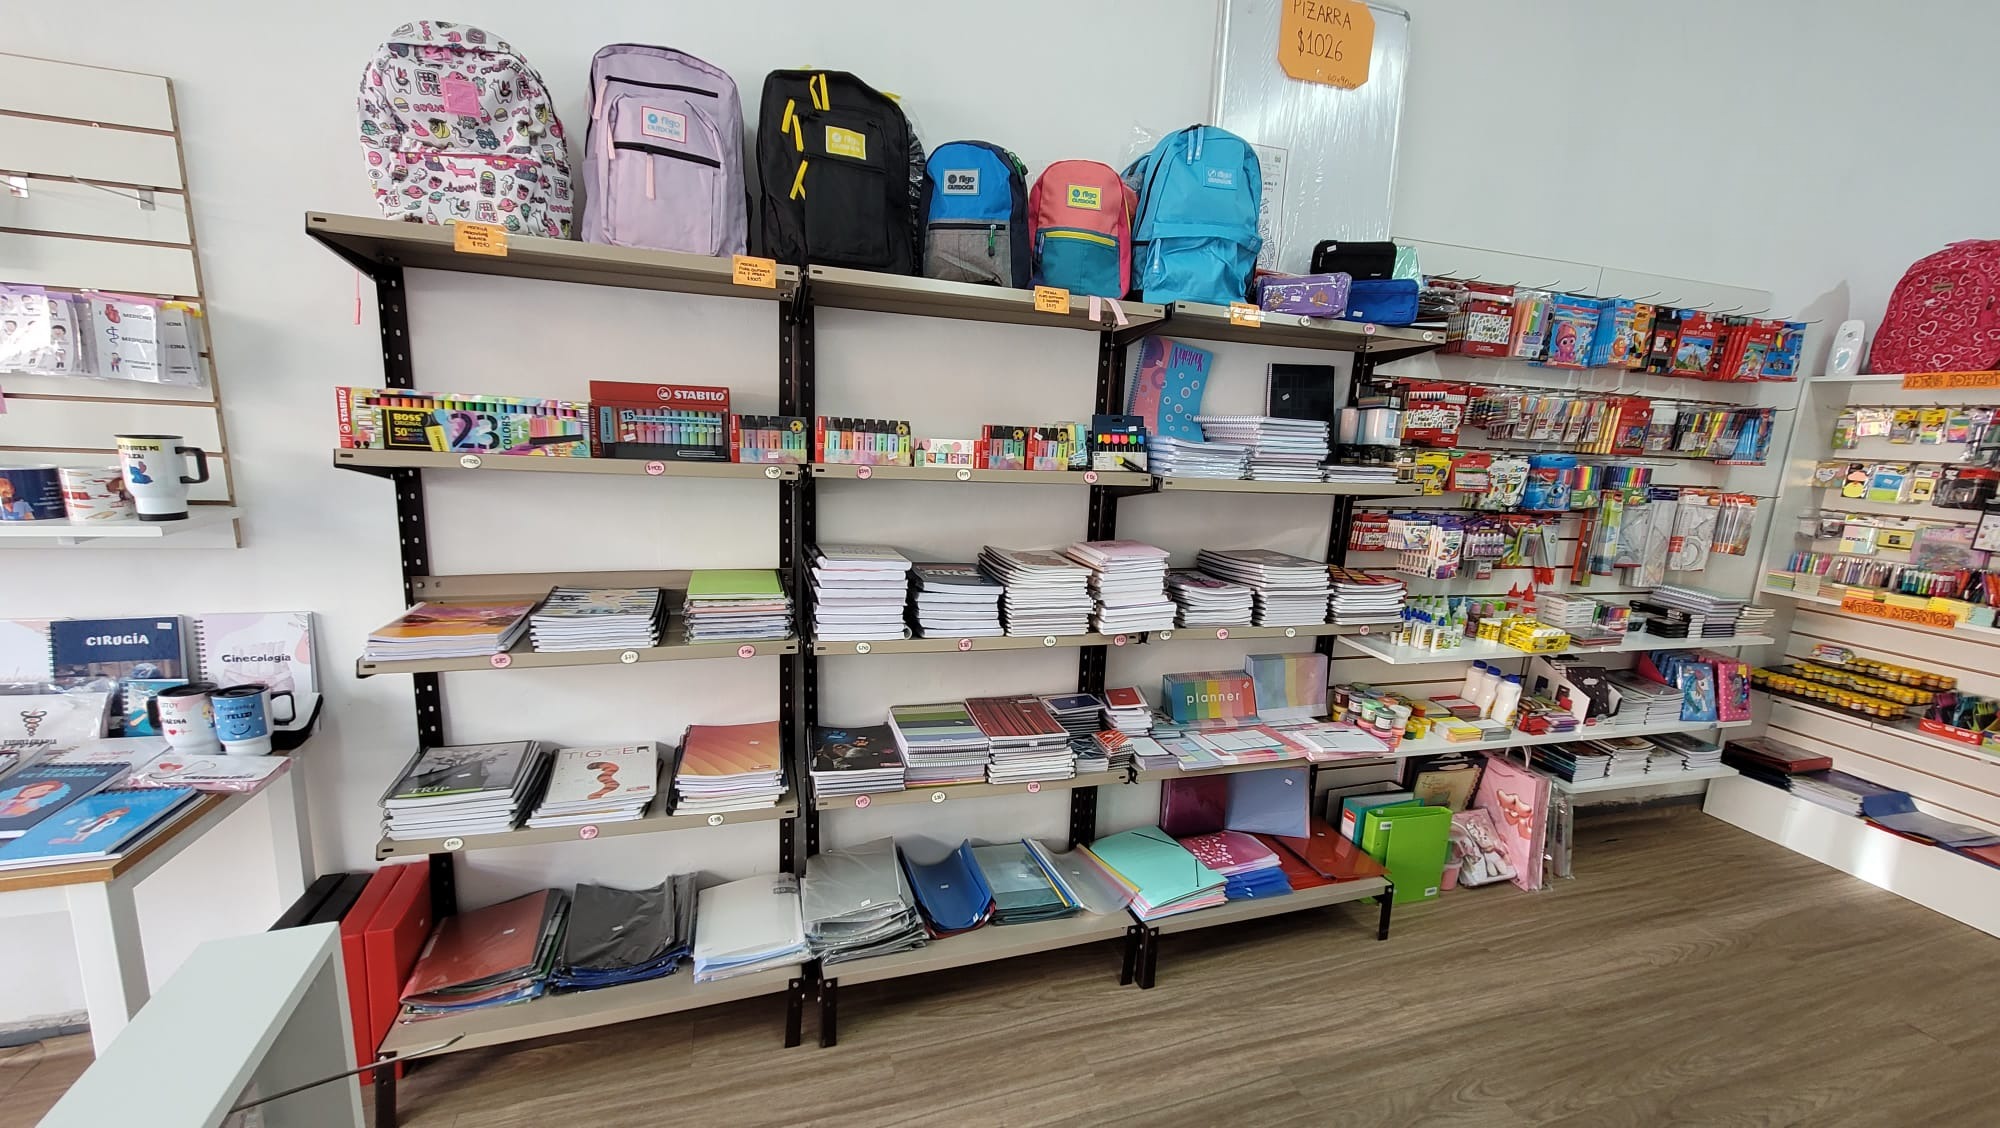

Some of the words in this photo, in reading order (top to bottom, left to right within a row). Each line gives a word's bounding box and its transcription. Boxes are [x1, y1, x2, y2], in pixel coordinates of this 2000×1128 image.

[1293, 0, 1352, 30] PIZARRA
[1297, 28, 1343, 62] $1026
[674, 390, 725, 401] STABILO
[338, 388, 348, 423] STABILO
[393, 412, 421, 421] BOSS
[623, 412, 634, 420] 15
[394, 427, 408, 436] 50
[450, 412, 500, 450] 23
[501, 415, 513, 451] COLORS
[85, 633, 150, 646] CIRUGÍA
[1186, 692, 1240, 706] planner
[567, 745, 650, 760] TIGGER
[409, 785, 450, 794] TRIP
